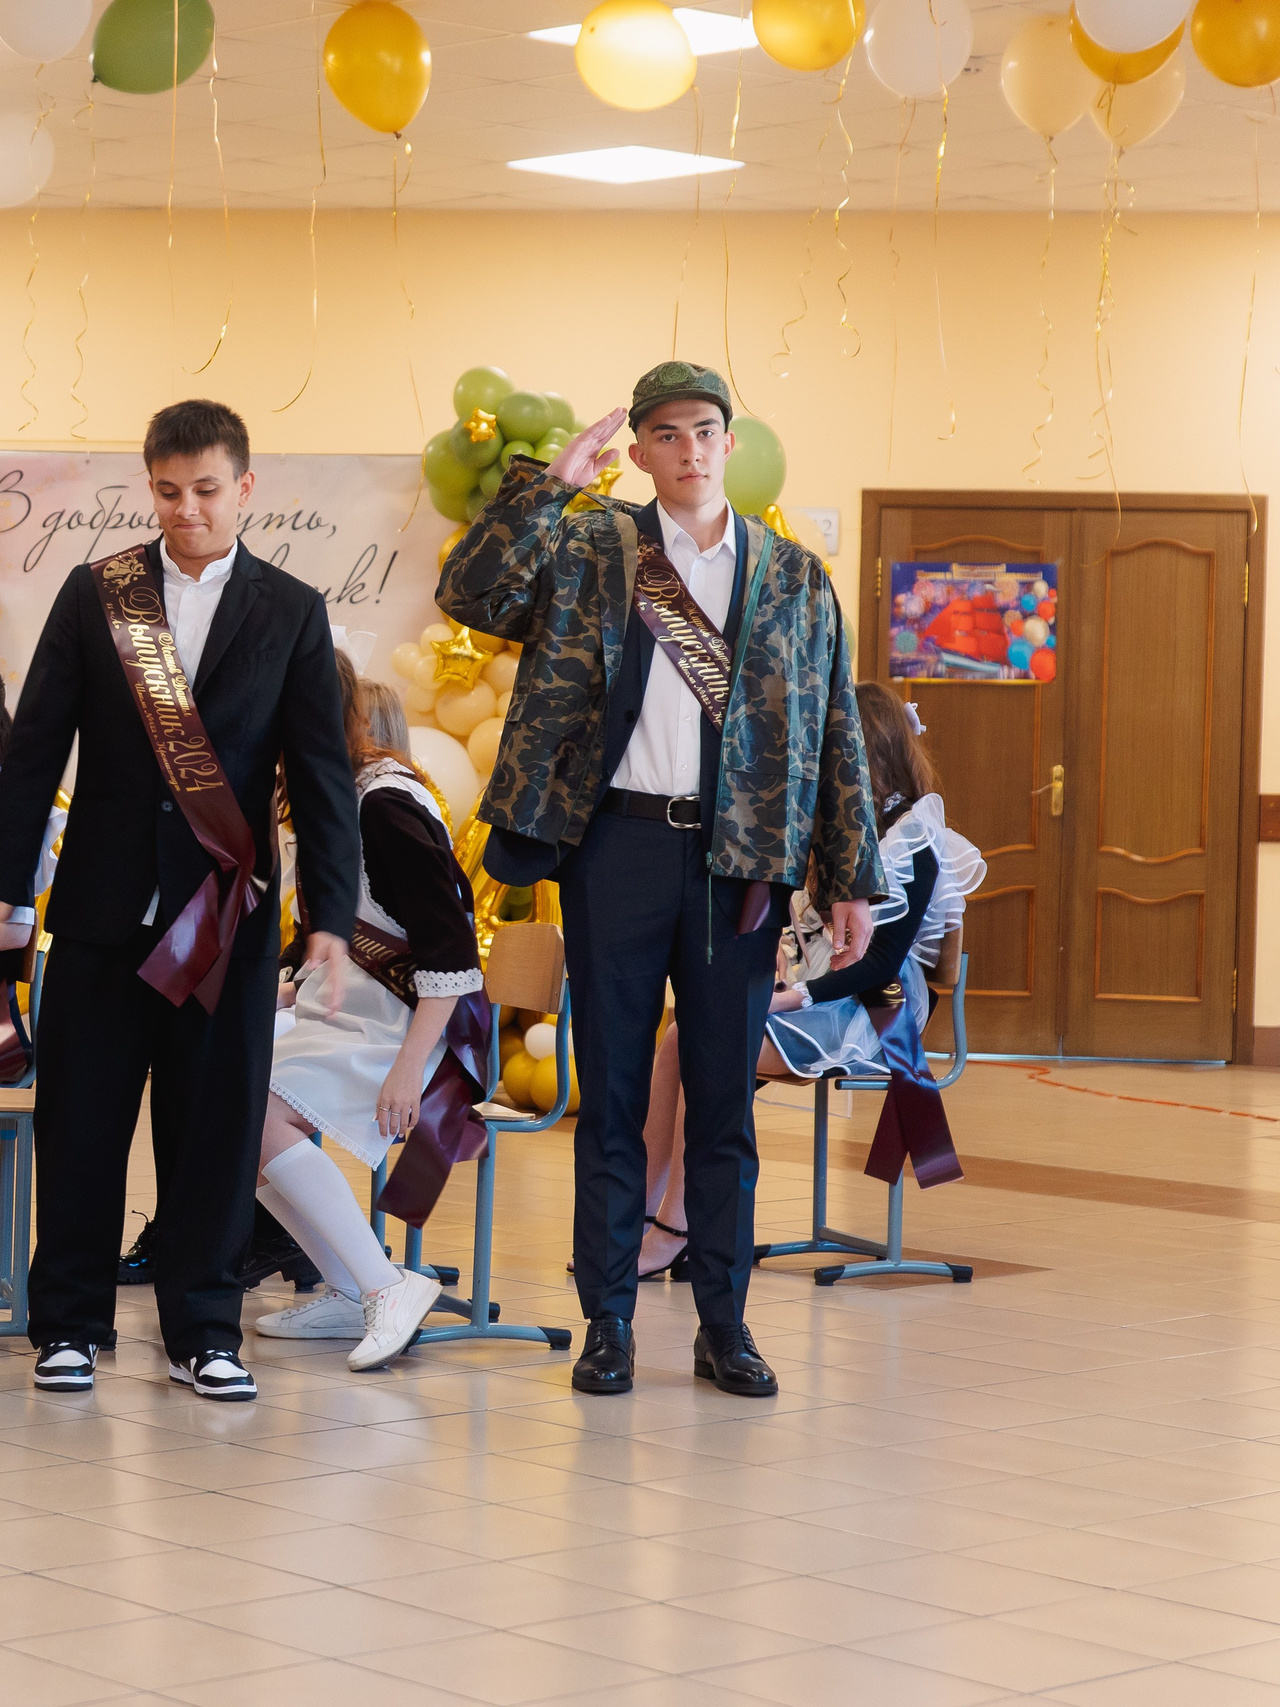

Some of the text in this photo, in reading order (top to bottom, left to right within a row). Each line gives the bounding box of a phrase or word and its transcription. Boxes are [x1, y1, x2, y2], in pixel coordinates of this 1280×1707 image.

[23, 484, 162, 575] добры
[237, 509, 337, 541] уть,
[118, 585, 224, 794] Выпускник 2024
[636, 563, 730, 703] Выпускник
